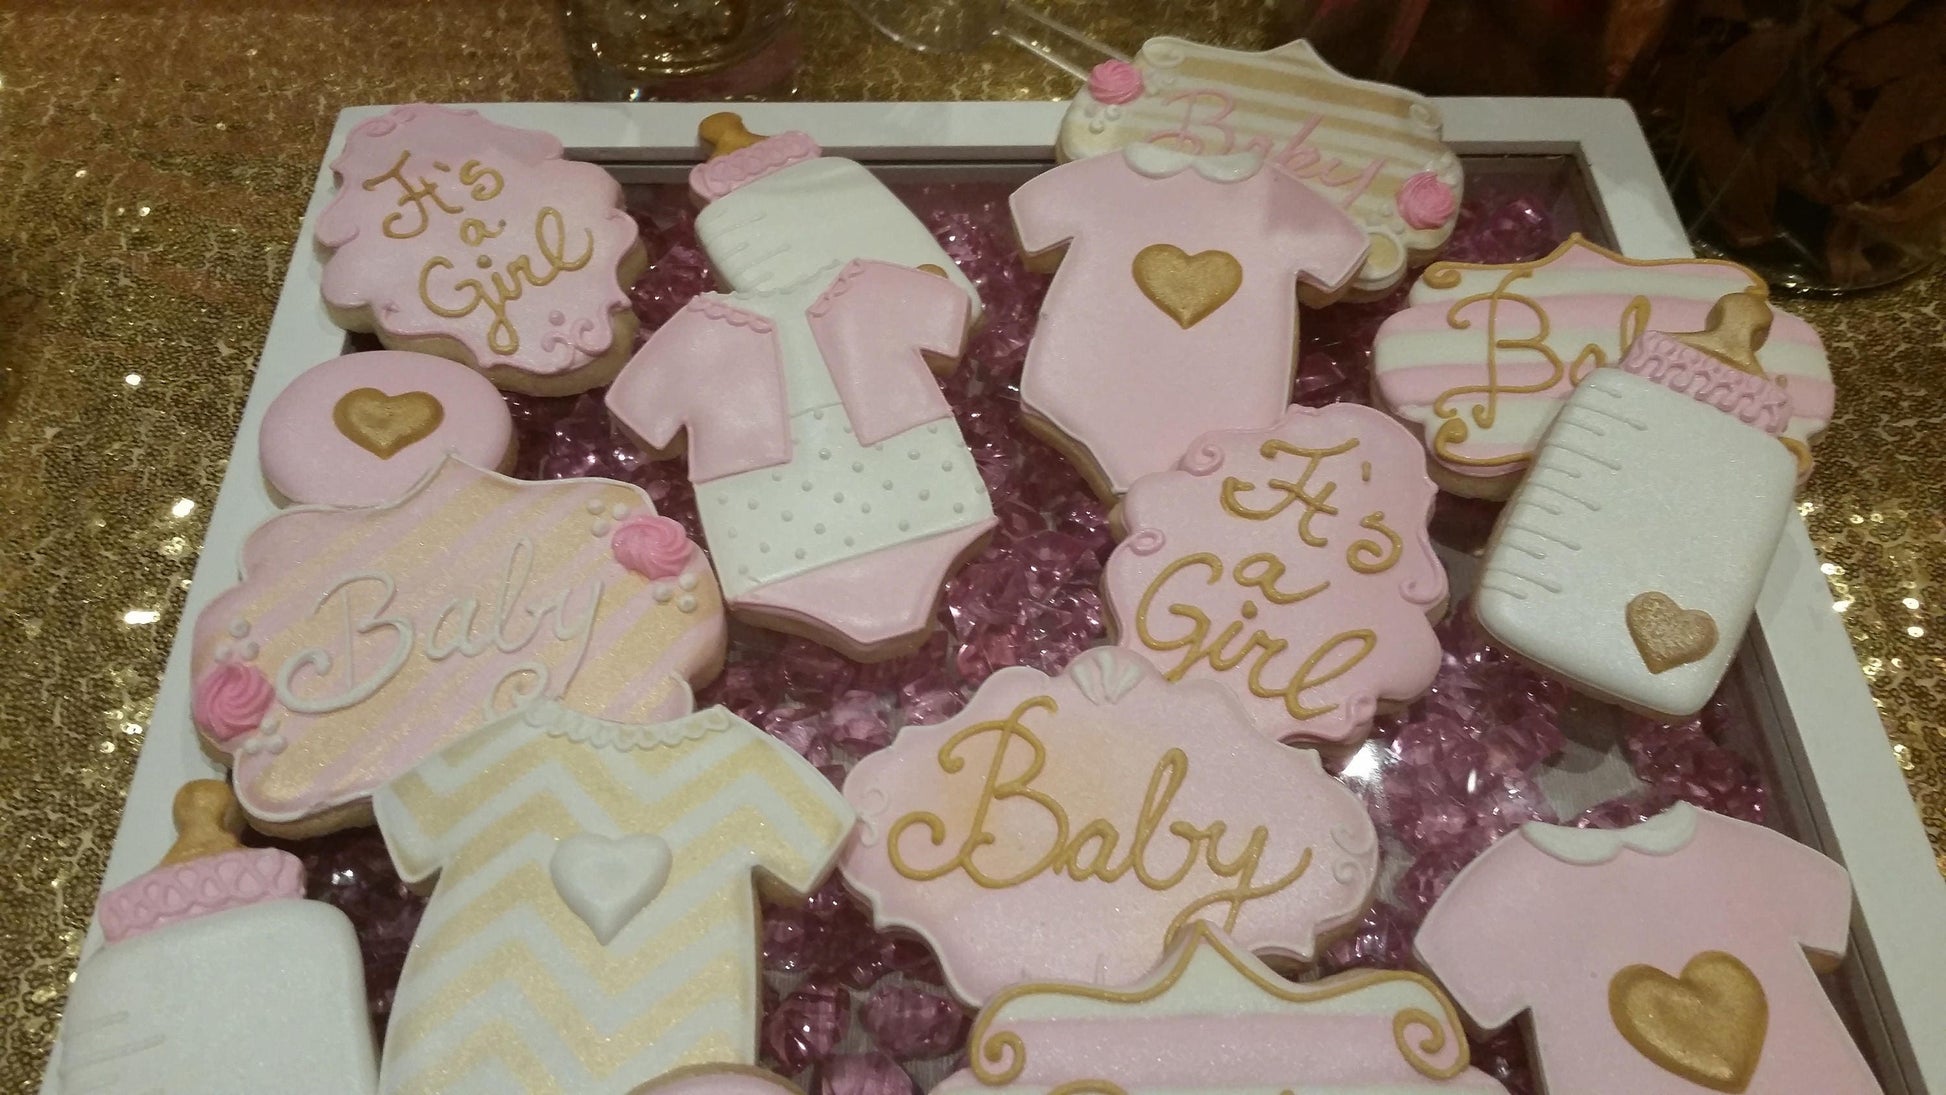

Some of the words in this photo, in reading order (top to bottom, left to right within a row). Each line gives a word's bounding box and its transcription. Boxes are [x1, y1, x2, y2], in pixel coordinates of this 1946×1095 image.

[362, 149, 504, 239] It's
[459, 217, 506, 247] a
[418, 206, 594, 356] Girl
[1220, 437, 1403, 574] It's
[275, 535, 606, 722] Baby
[1136, 552, 1378, 721] Girl
[1233, 552, 1331, 605] a
[888, 695, 1314, 957] Baby
